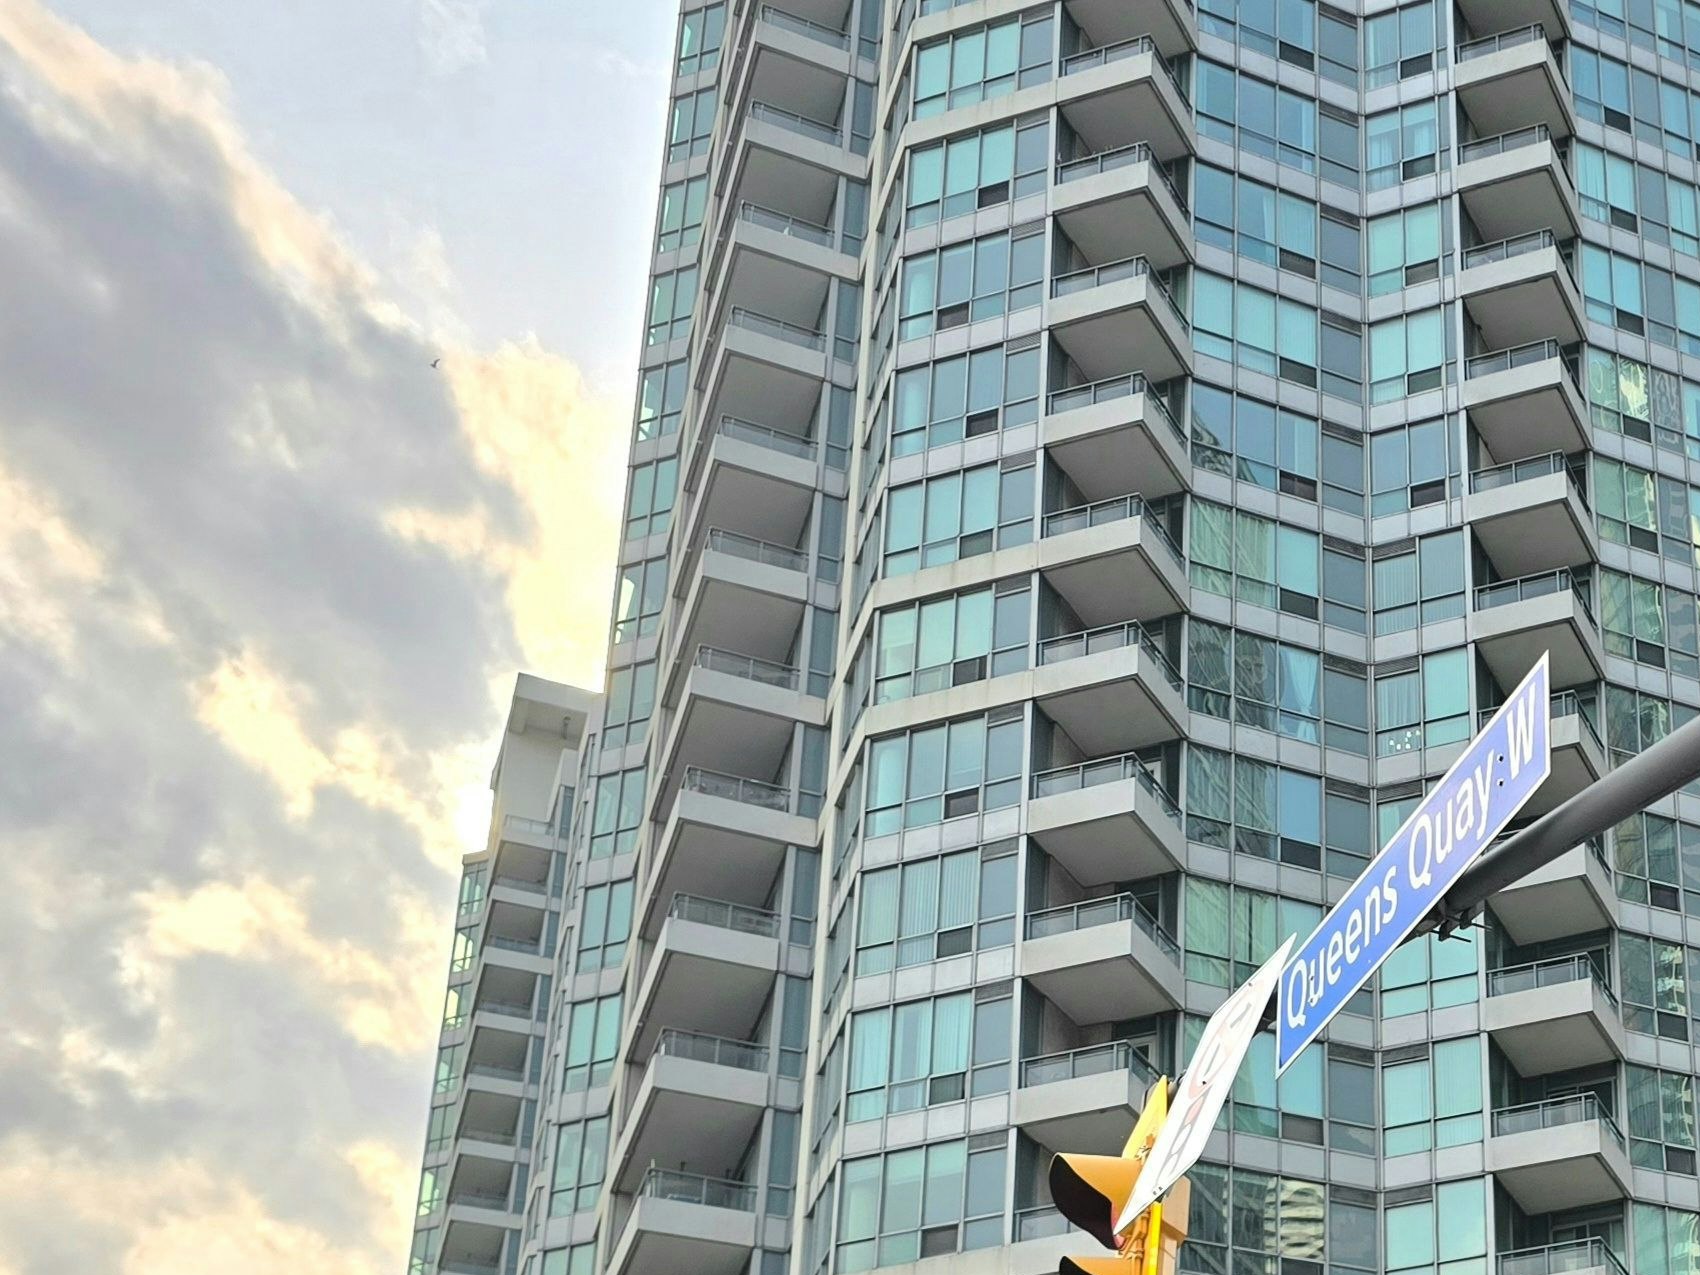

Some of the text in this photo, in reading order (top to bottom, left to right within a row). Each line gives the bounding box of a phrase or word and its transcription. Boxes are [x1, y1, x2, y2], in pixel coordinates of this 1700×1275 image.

[1285, 681, 1537, 1030] Queens Quay W
